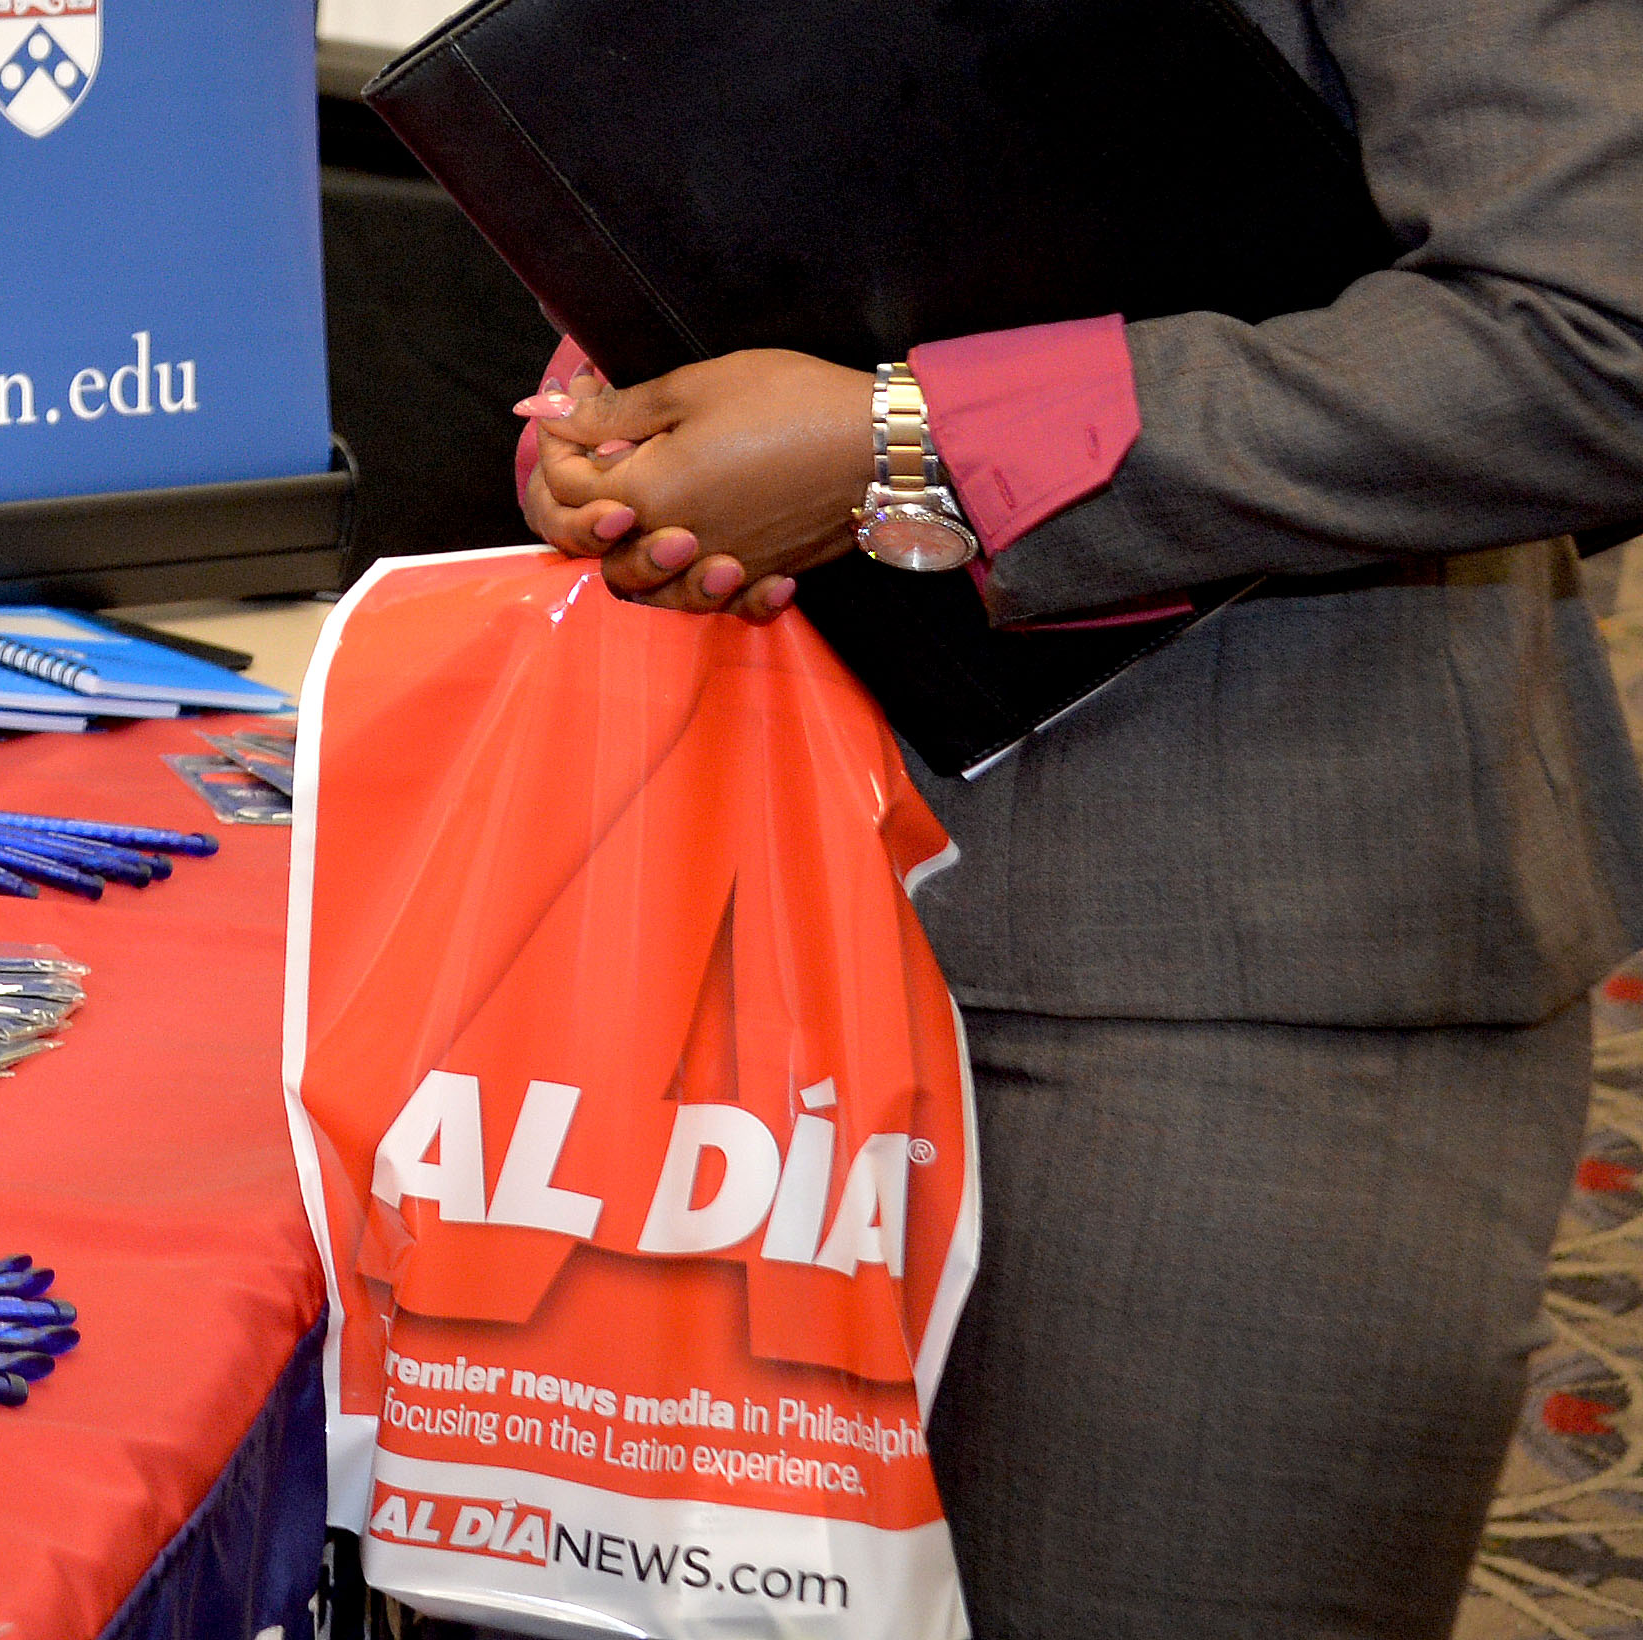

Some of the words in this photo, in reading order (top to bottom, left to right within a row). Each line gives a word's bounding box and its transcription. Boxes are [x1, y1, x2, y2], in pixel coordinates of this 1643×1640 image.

[371, 1069, 604, 1240] AL
[384, 1346, 507, 1394] remier
[511, 1366, 617, 1417] news
[624, 1388, 736, 1431] media
[743, 1397, 770, 1436] in
[777, 1397, 929, 1464] Philadelphi
[384, 1386, 500, 1446] focusing
[505, 1414, 543, 1447] on
[549, 1414, 597, 1458] the
[603, 1425, 687, 1474] Latino
[692, 1443, 866, 1496] experience.
[371, 1494, 442, 1544] AL
